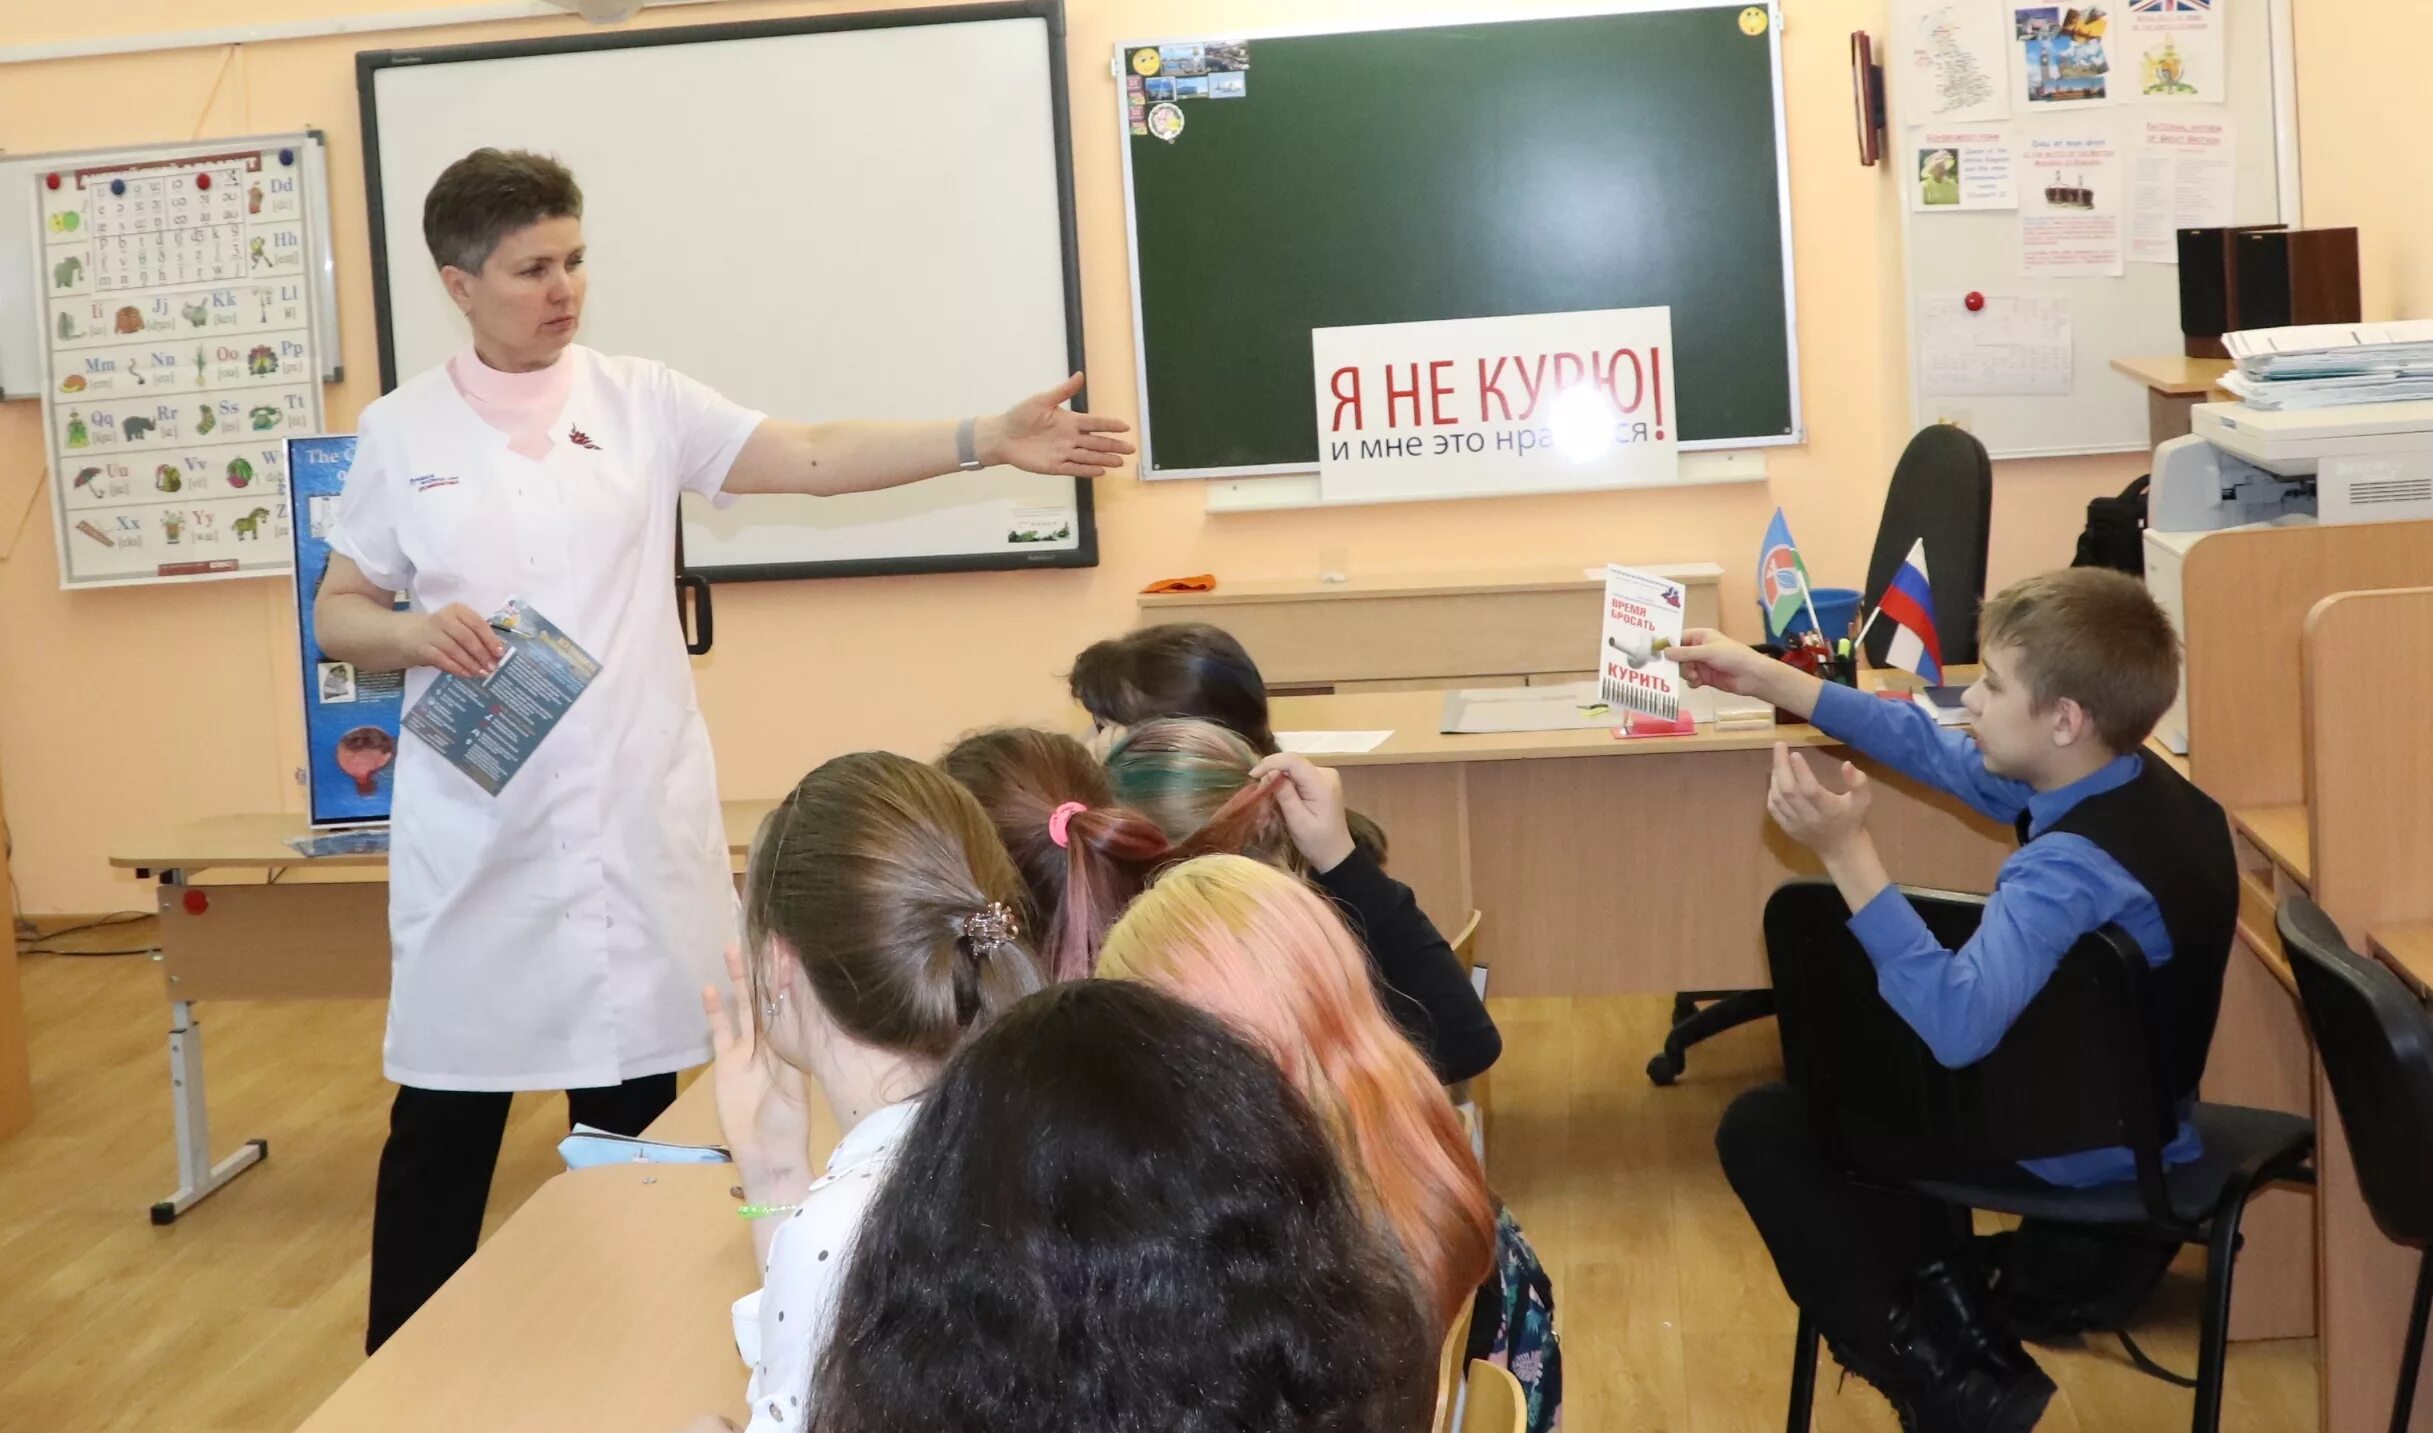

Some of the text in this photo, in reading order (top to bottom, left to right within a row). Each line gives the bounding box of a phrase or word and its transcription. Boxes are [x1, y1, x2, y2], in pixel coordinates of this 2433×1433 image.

[270, 178, 293, 194] Dd
[273, 232, 297, 247] Hh
[212, 292, 236, 307] Kk
[282, 286, 297, 301] Ll
[91, 304, 103, 318] Ii
[152, 299, 168, 314] Jj
[217, 347, 239, 361] Oo
[282, 341, 304, 356] Pp
[86, 357, 116, 373] Mm
[152, 352, 175, 367] Nn
[285, 394, 304, 410] Tt
[1330, 366, 1362, 432] Я
[1385, 360, 1459, 428] НЕ
[157, 405, 178, 420] Rr
[220, 400, 240, 415] Ss
[91, 410, 113, 427] Qq
[1332, 422, 1648, 461] и мне это нрася
[184, 457, 207, 472] Vv
[263, 451, 283, 465] W
[307, 450, 339, 464] The
[107, 463, 129, 478] Uu
[116, 516, 140, 530] Xx
[191, 510, 215, 526] Yy
[1612, 598, 1647, 617] ВРЕМЯ
[1611, 610, 1656, 632] БРОСАТЬ
[1608, 662, 1671, 693] КУРИТЬ
